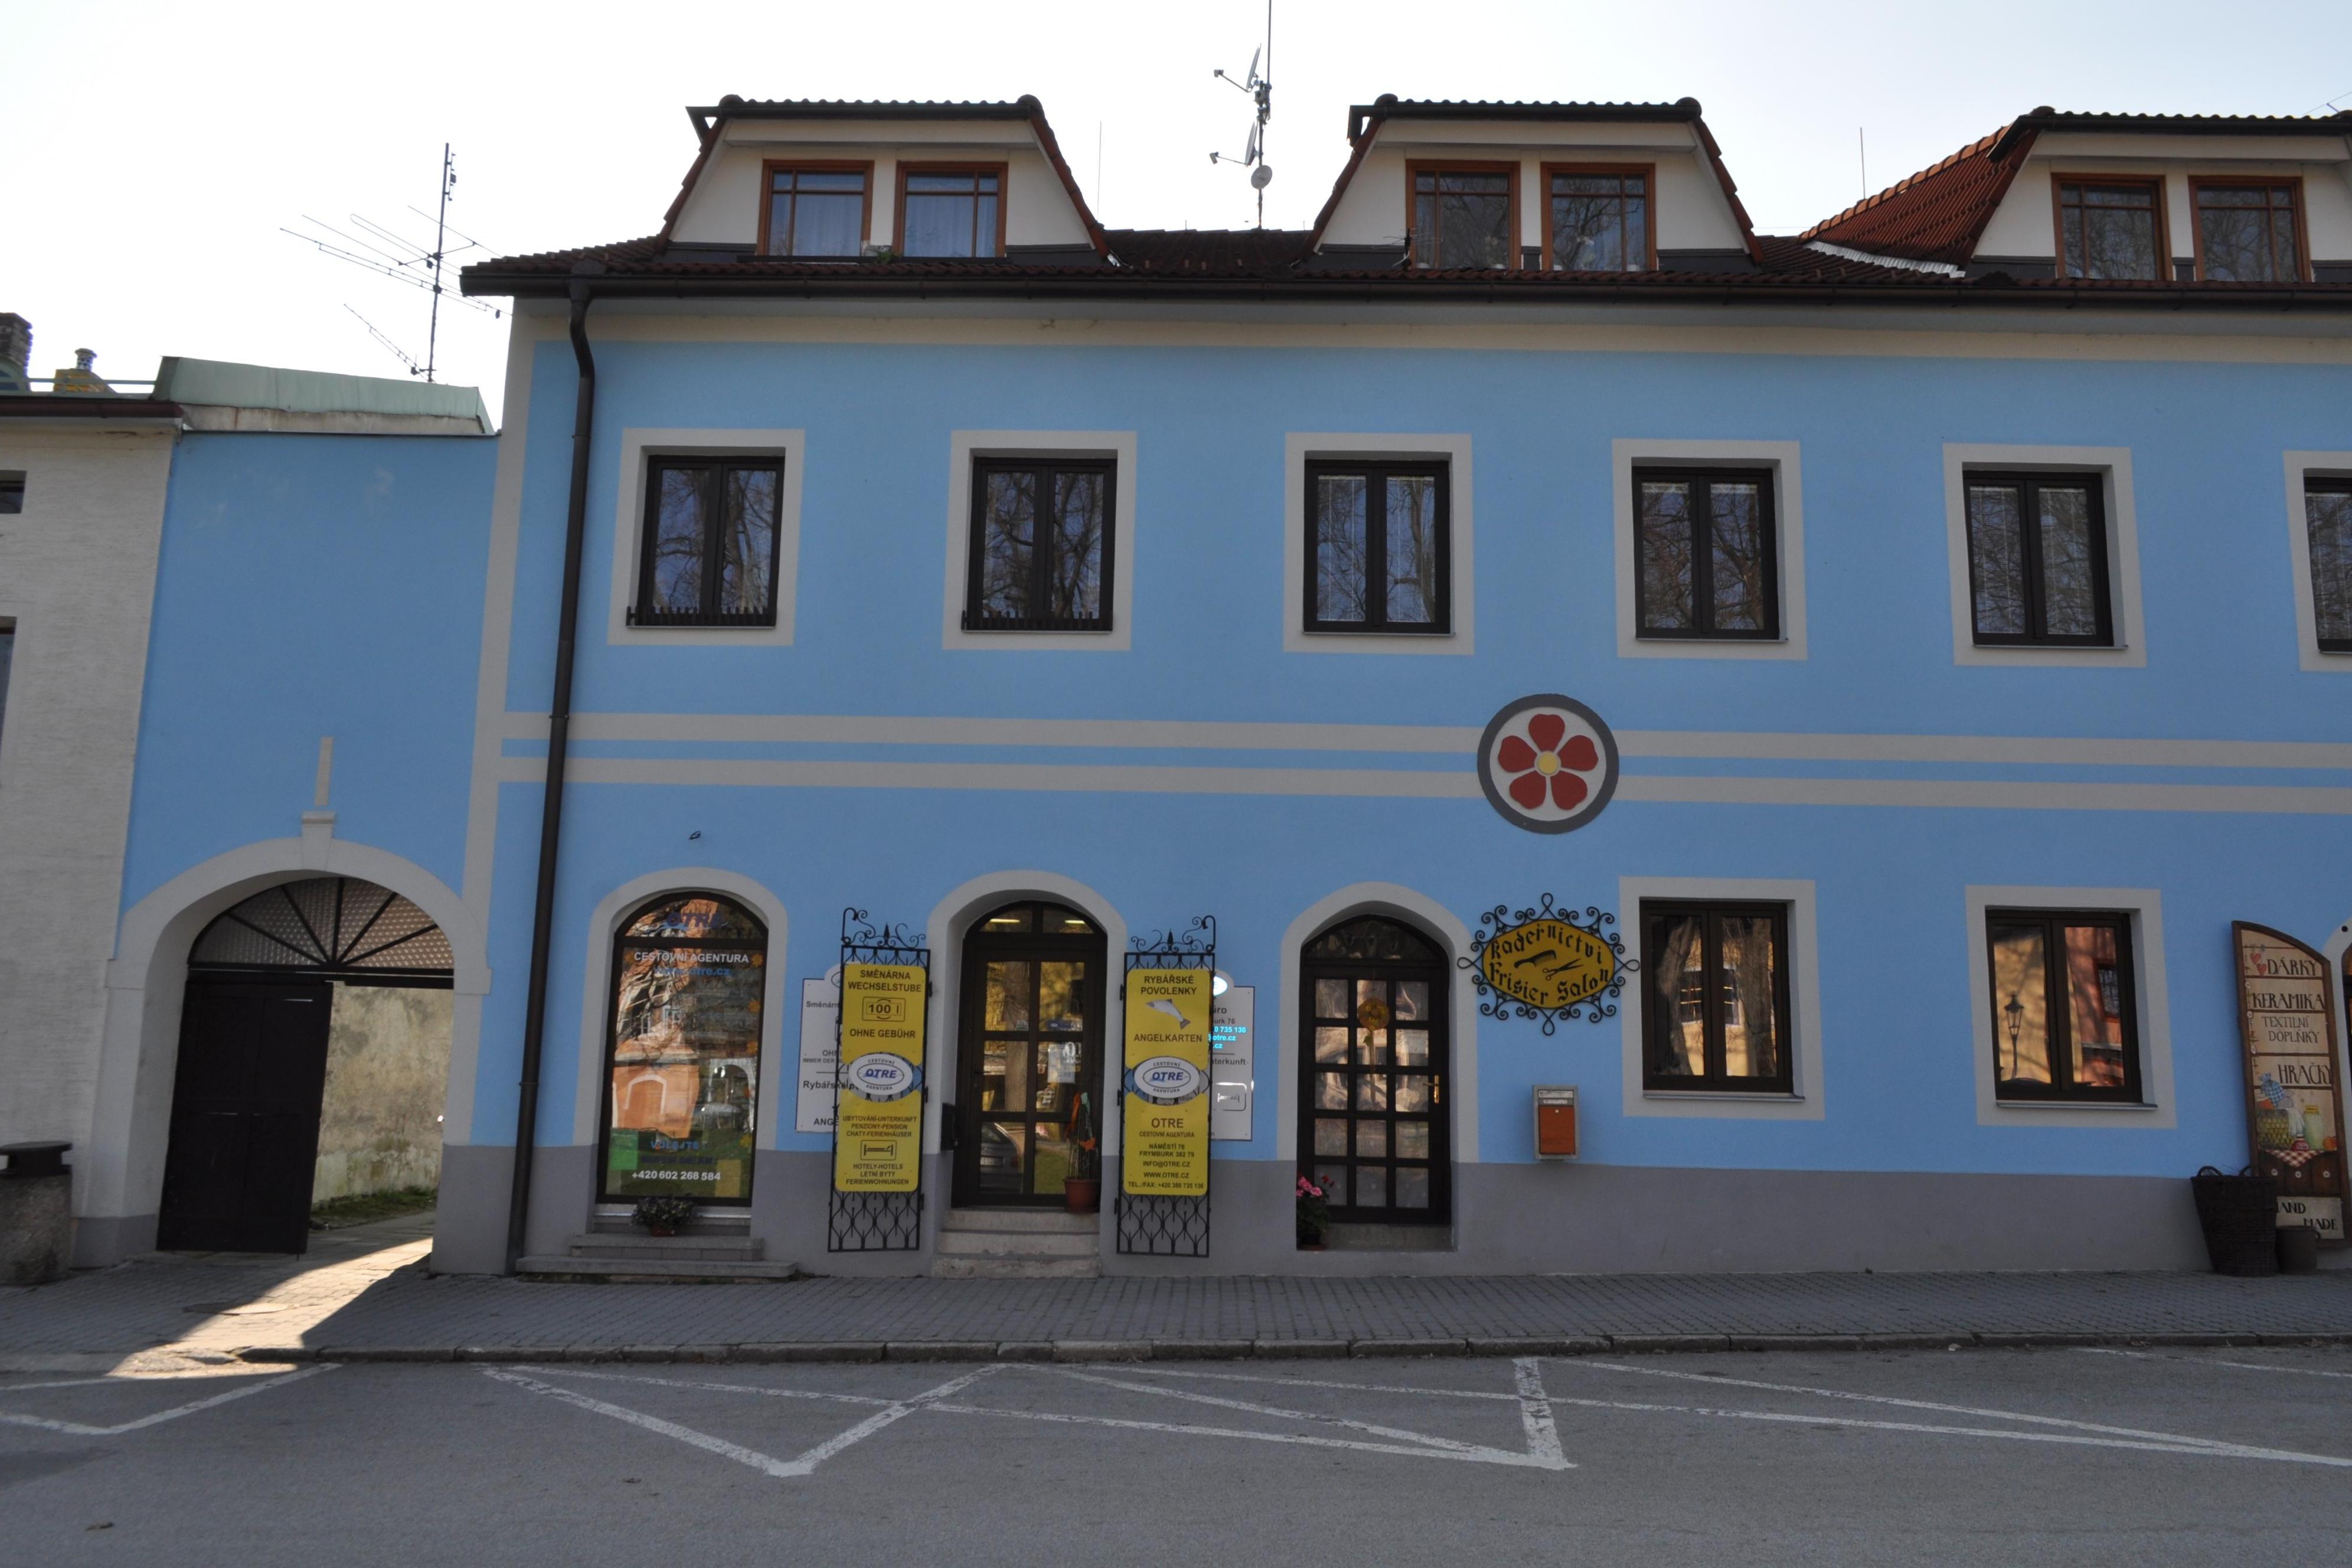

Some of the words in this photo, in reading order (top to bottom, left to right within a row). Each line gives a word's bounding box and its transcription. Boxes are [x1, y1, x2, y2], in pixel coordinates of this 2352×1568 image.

[667, 912, 722, 928] OTRE
[634, 952, 687, 963] CESTOVNÍ
[689, 953, 749, 963] AGENTURA
[2267, 957, 2317, 976] DÁRKY
[860, 969, 911, 980] SMĚNÁRNA
[1144, 974, 1194, 984] RYBÁŘSKÉ
[848, 982, 922, 992] WECHSELSTUBE
[1489, 962, 1549, 1005] Frisier
[1557, 968, 1609, 1002] Salon
[1141, 986, 1197, 995] POVOLENKY
[2252, 993, 2325, 1010] KERAMIKA
[868, 1004, 891, 1014] 100
[2262, 1015, 2309, 1028] TEXTILNÍ
[850, 1028, 876, 1037] OHNE
[878, 1028, 916, 1038] GEBÜHR
[1133, 1034, 1202, 1043] ANGELKARTEN
[2269, 1030, 2320, 1043] DOPLŇKY
[865, 1069, 897, 1079] OTRE
[1152, 1072, 1184, 1081] OTRE
[2278, 1063, 2331, 1085] HRAČKY
[1151, 1118, 1184, 1128] OTRE
[632, 1170, 657, 1180] +420
[659, 1170, 678, 1180] 602
[680, 1171, 700, 1180] 268
[701, 1171, 721, 1181] 584
[2304, 1218, 2338, 1230] MADE
